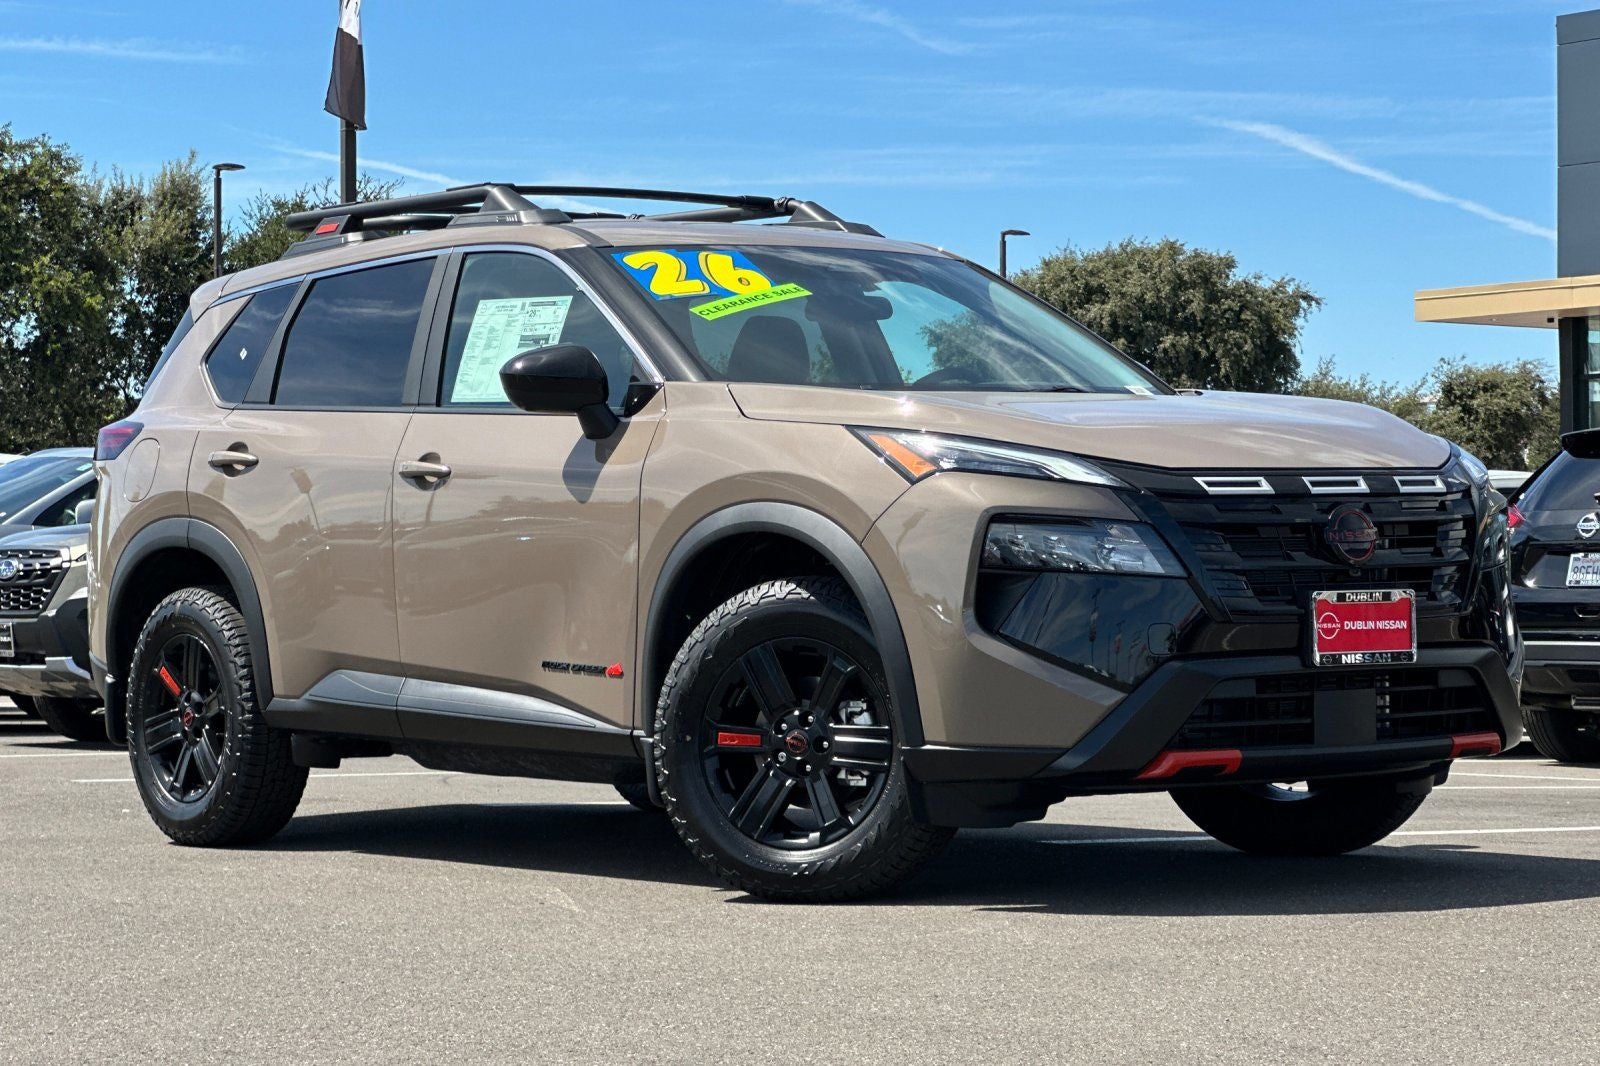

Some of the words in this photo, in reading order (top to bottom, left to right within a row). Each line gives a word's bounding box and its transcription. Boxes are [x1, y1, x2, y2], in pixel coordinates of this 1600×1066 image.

[622, 251, 772, 296] 26
[699, 293, 771, 316] CLEARANCE
[772, 286, 804, 297] SALE
[1346, 592, 1382, 602] DUBLIN
[1344, 621, 1375, 630] DUBLIN
[1376, 620, 1407, 629] NISSAN
[1341, 653, 1391, 664] NISSAN
